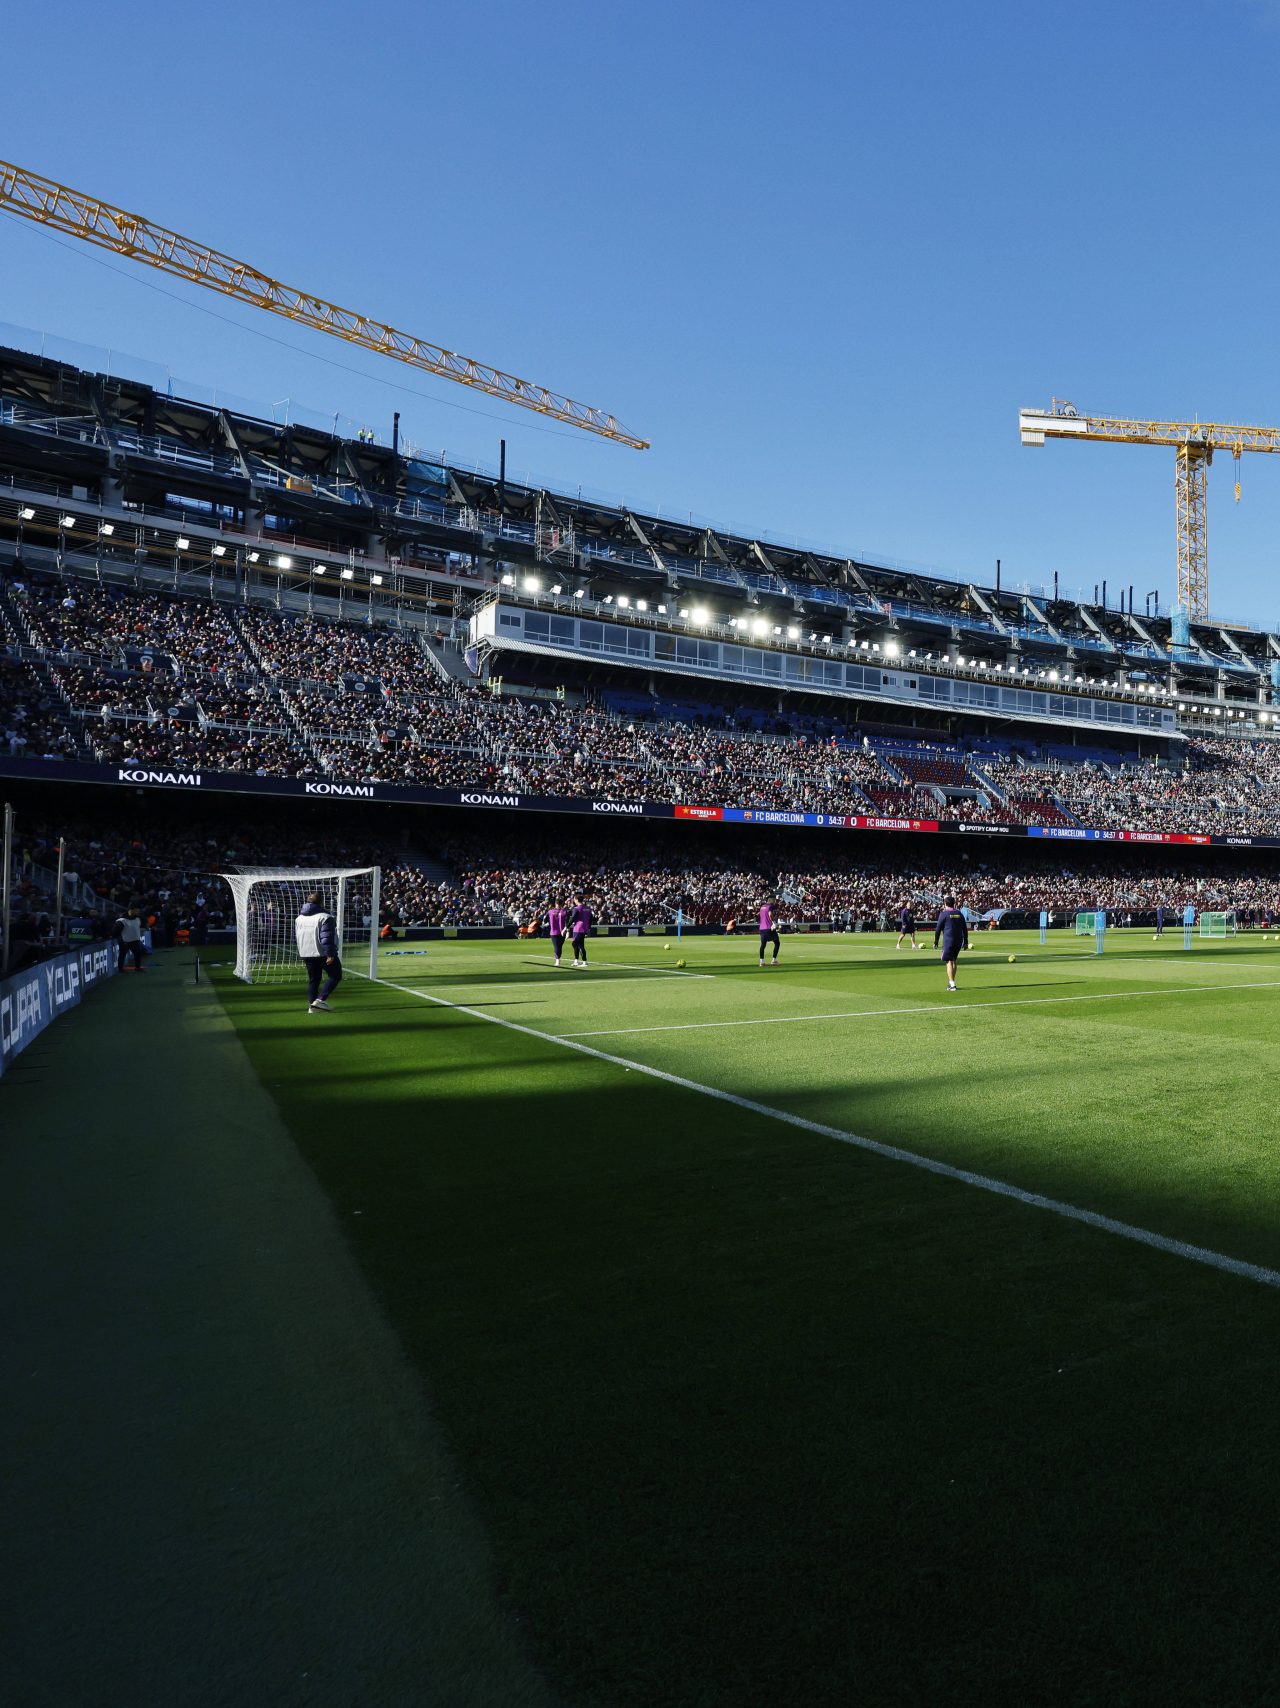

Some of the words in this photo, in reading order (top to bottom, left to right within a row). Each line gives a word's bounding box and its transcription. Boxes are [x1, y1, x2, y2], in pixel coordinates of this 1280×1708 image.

[119, 768, 201, 786] KONAMI
[305, 781, 375, 797] KONAMI
[460, 792, 520, 806] KONAMI
[592, 801, 644, 814] KONAMI
[756, 812, 764, 821] FC
[766, 811, 805, 823] BARCELONA
[817, 815, 823, 824] 0
[829, 816, 845, 825] 34:37
[850, 817, 857, 826] 0
[866, 818, 874, 826] FC
[876, 819, 909, 828] BARCELONA
[1051, 828, 1057, 836] FC
[1058, 829, 1086, 837] BARCELONA
[1130, 832, 1136, 840] FC
[1137, 832, 1163, 841] BARCELONA
[84, 948, 108, 983] CUPRA
[1, 979, 42, 1054] CUPRA
